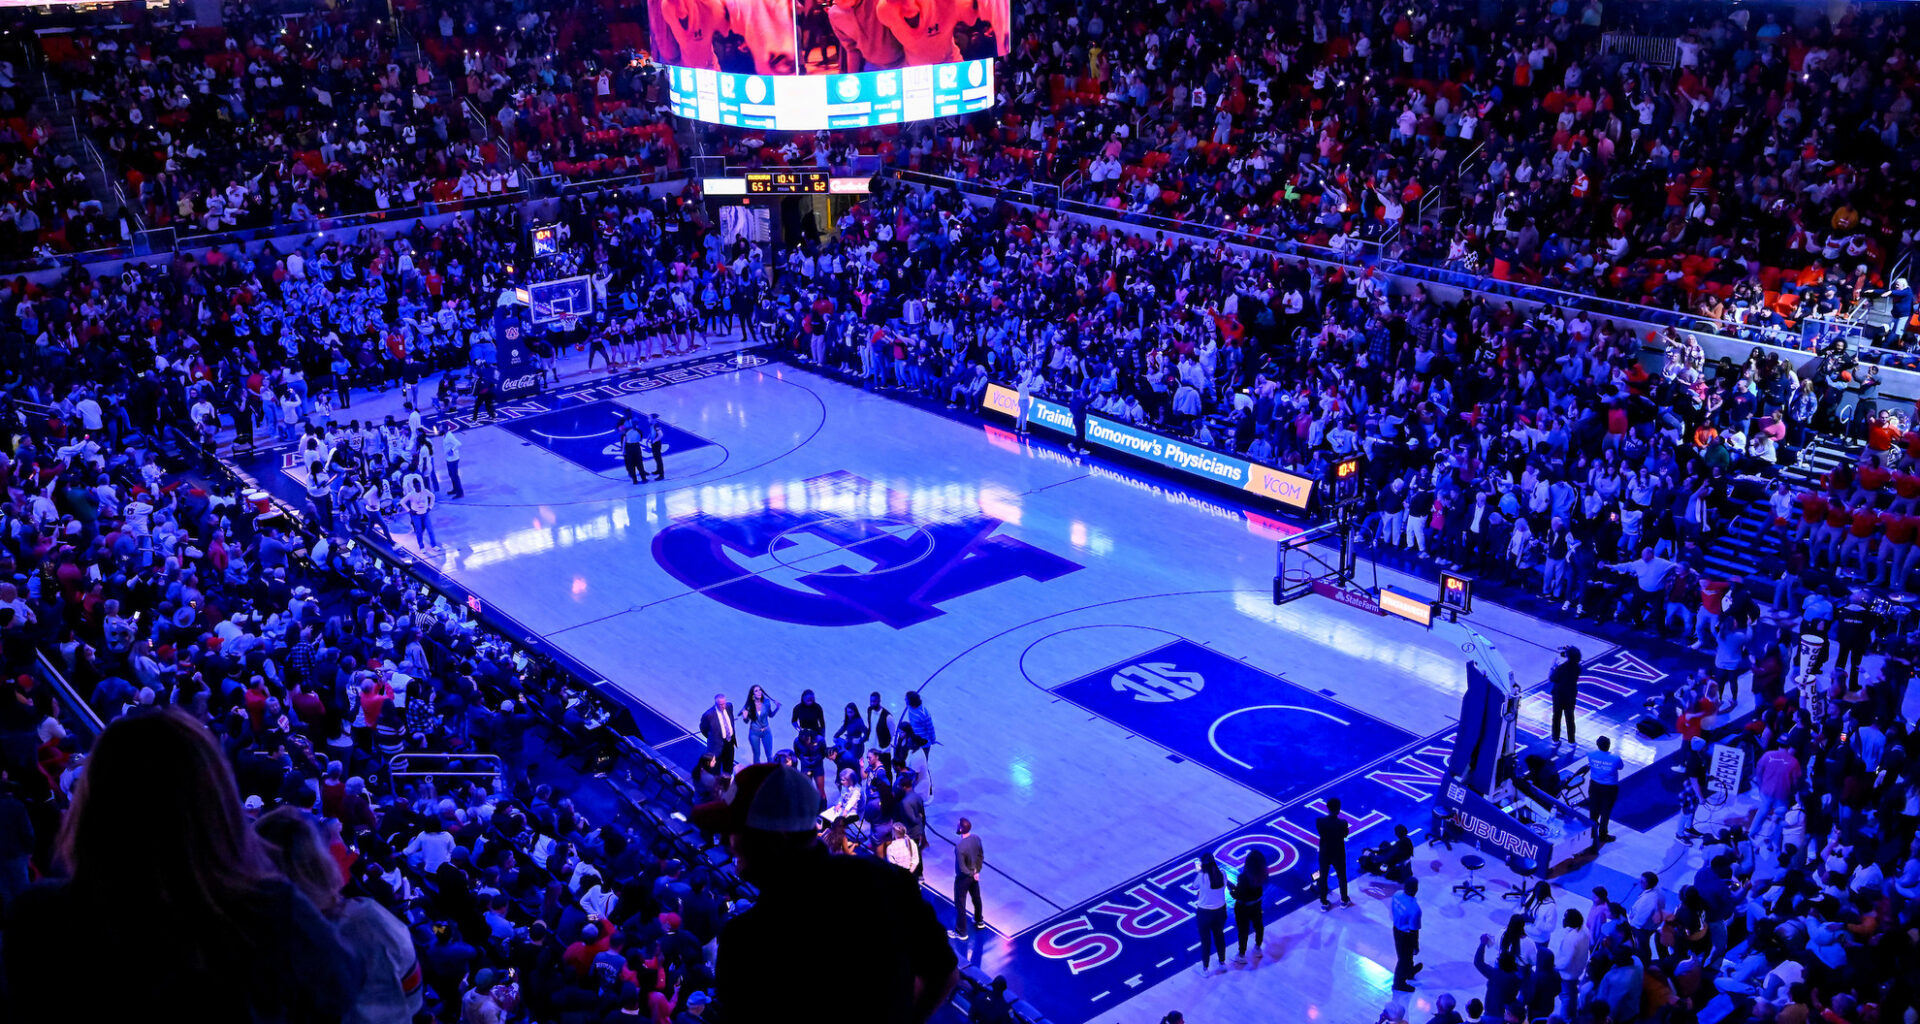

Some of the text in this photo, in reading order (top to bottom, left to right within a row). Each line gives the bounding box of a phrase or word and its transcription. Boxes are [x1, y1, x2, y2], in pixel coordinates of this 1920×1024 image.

[752, 181, 764, 192] 65
[814, 181, 826, 192] 62
[1088, 420, 1162, 457] Tomorrow's
[1164, 444, 1242, 481] Physicians
[1338, 461, 1356, 477] 10.4
[1263, 473, 1301, 500] VCOM
[1447, 578, 1463, 591] 10.4
[1444, 806, 1539, 860] AUBURN
